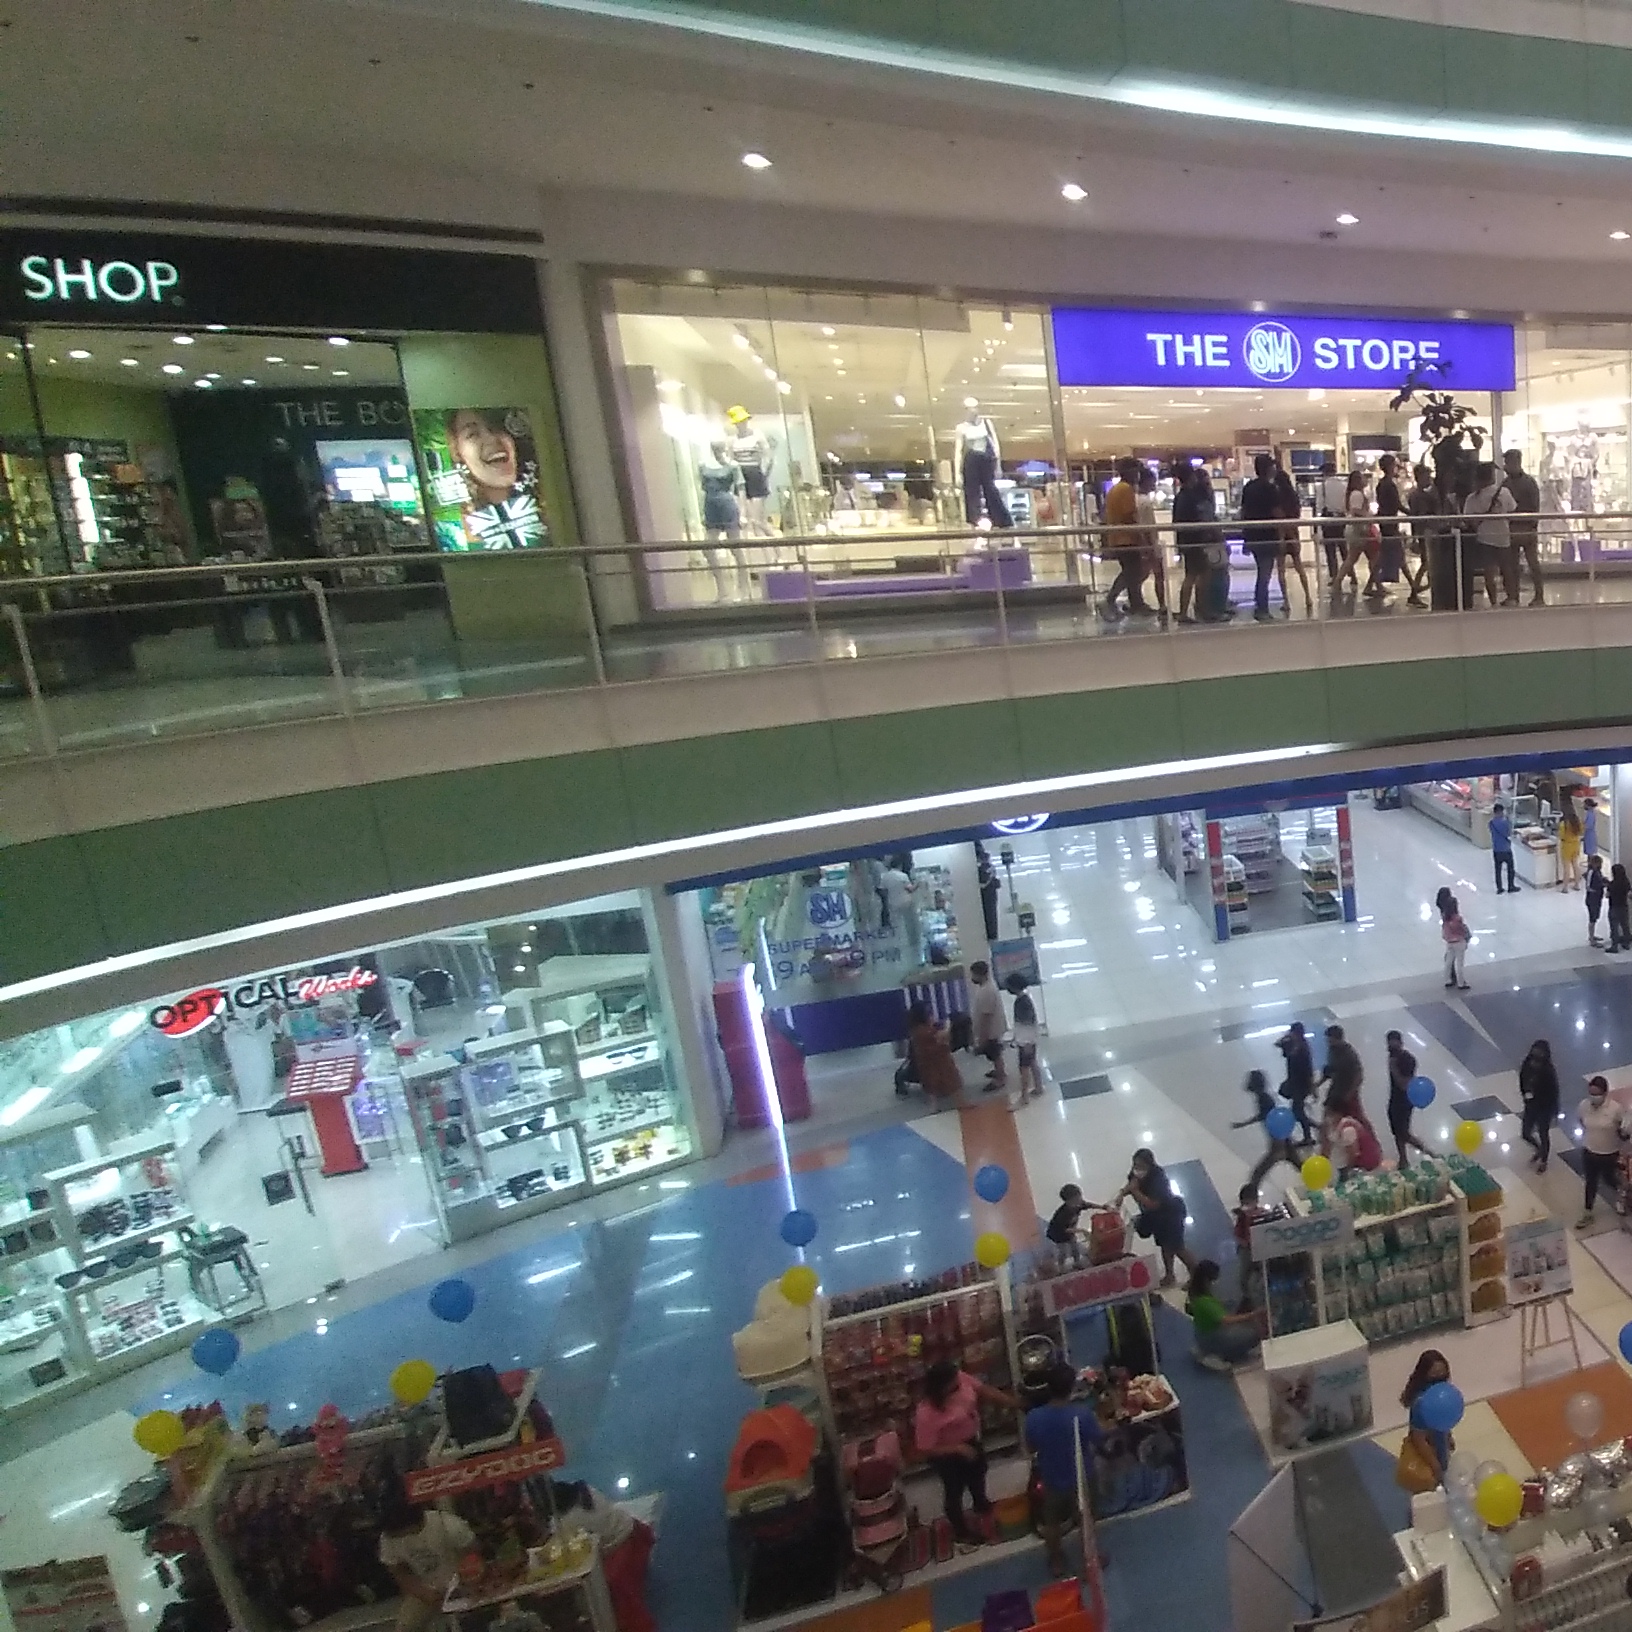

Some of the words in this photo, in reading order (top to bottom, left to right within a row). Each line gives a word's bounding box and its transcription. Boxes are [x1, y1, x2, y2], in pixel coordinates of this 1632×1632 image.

[20, 255, 179, 302] SHOP
[1146, 333, 1231, 367] THE
[1248, 328, 1295, 375] SM
[1313, 337, 1440, 371] STORE
[275, 401, 344, 427] THE
[150, 975, 302, 1029] OPTICAL
